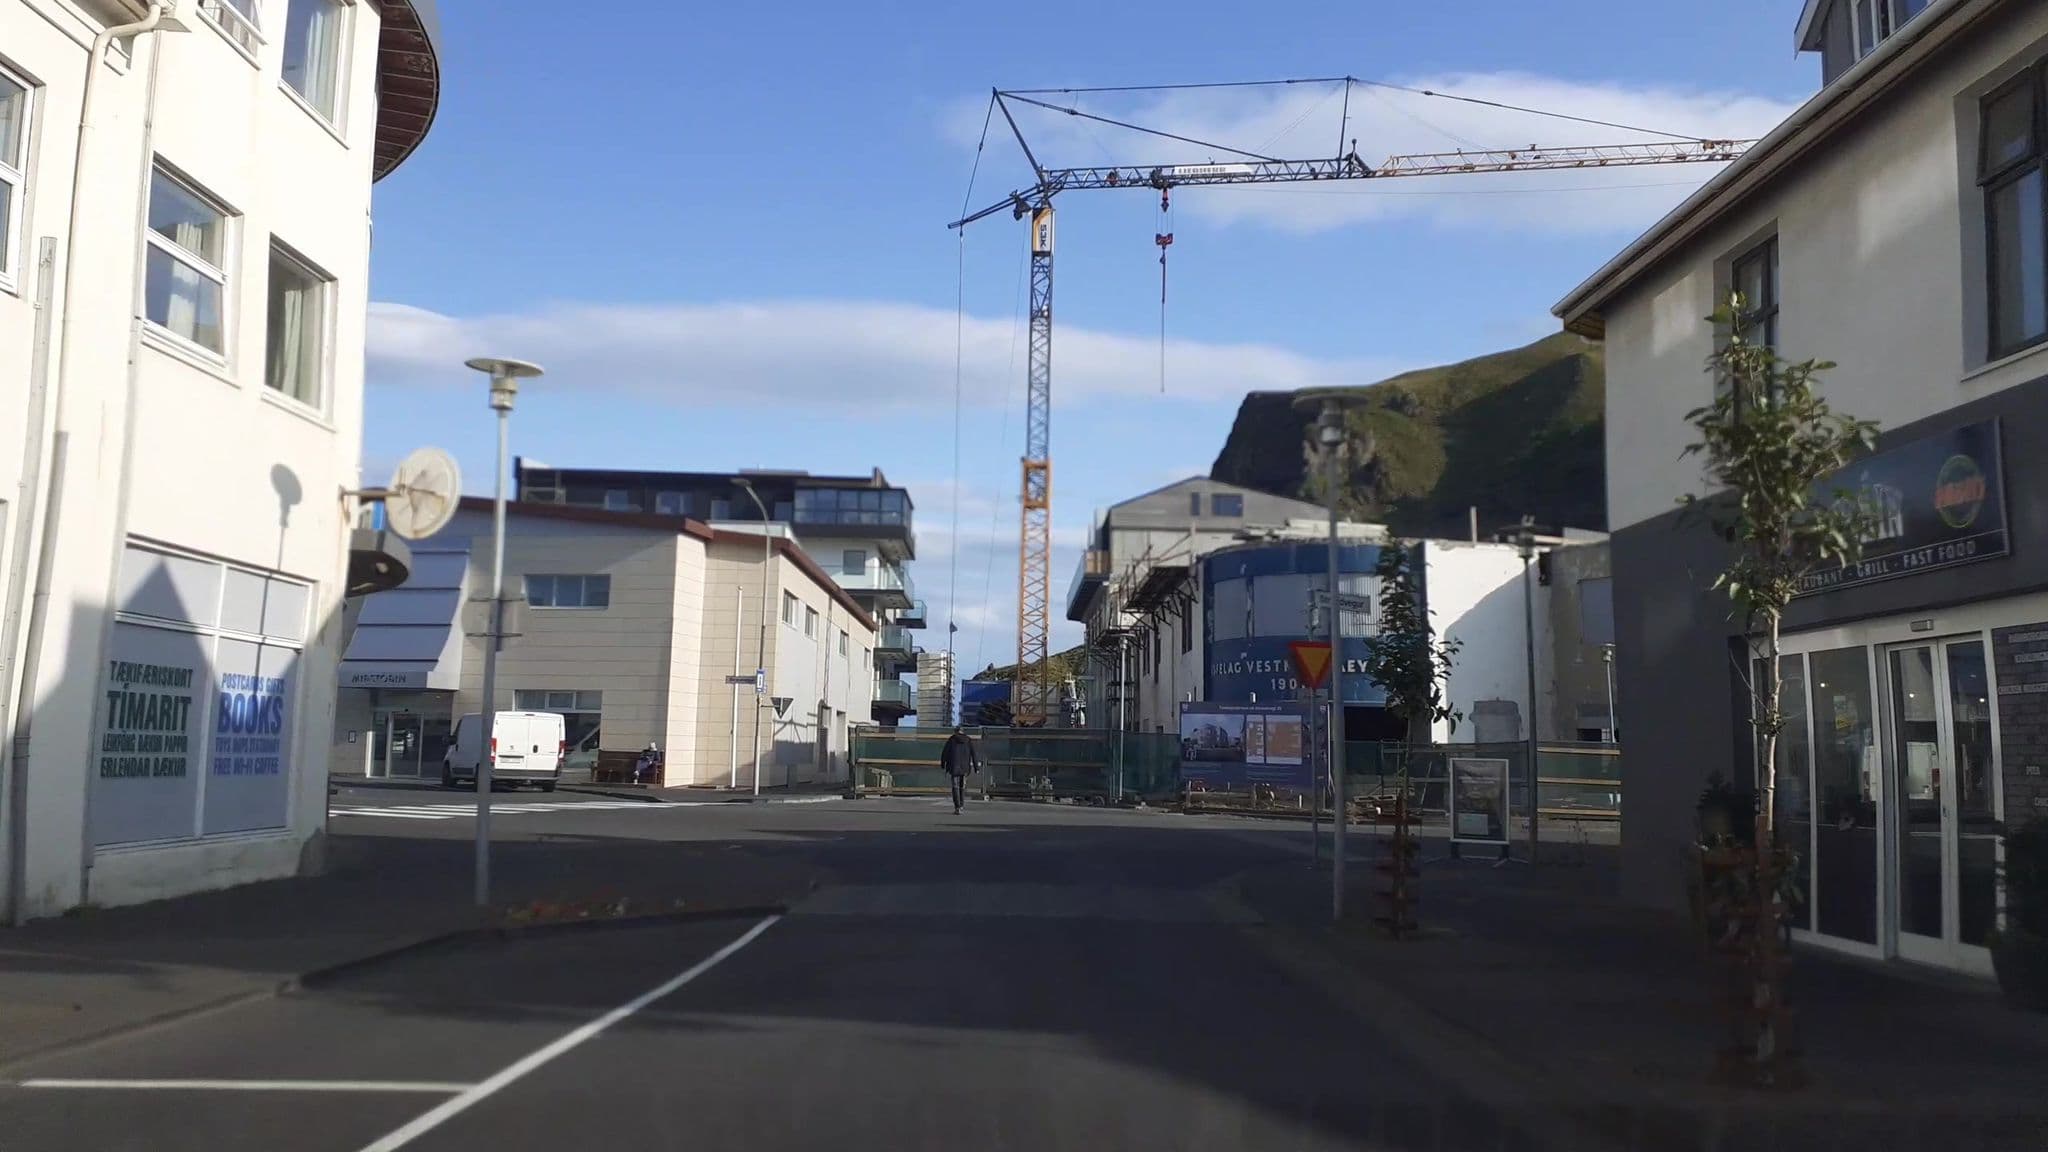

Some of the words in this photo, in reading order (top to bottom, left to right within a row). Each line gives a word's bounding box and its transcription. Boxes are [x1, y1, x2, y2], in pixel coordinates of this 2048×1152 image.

[1856, 560, 1889, 577] GRILL
[1903, 550, 1934, 569] FAST
[1938, 541, 1976, 562] FOOD
[106, 682, 192, 731] TÍMARIT
[217, 692, 283, 734] BOOKS
